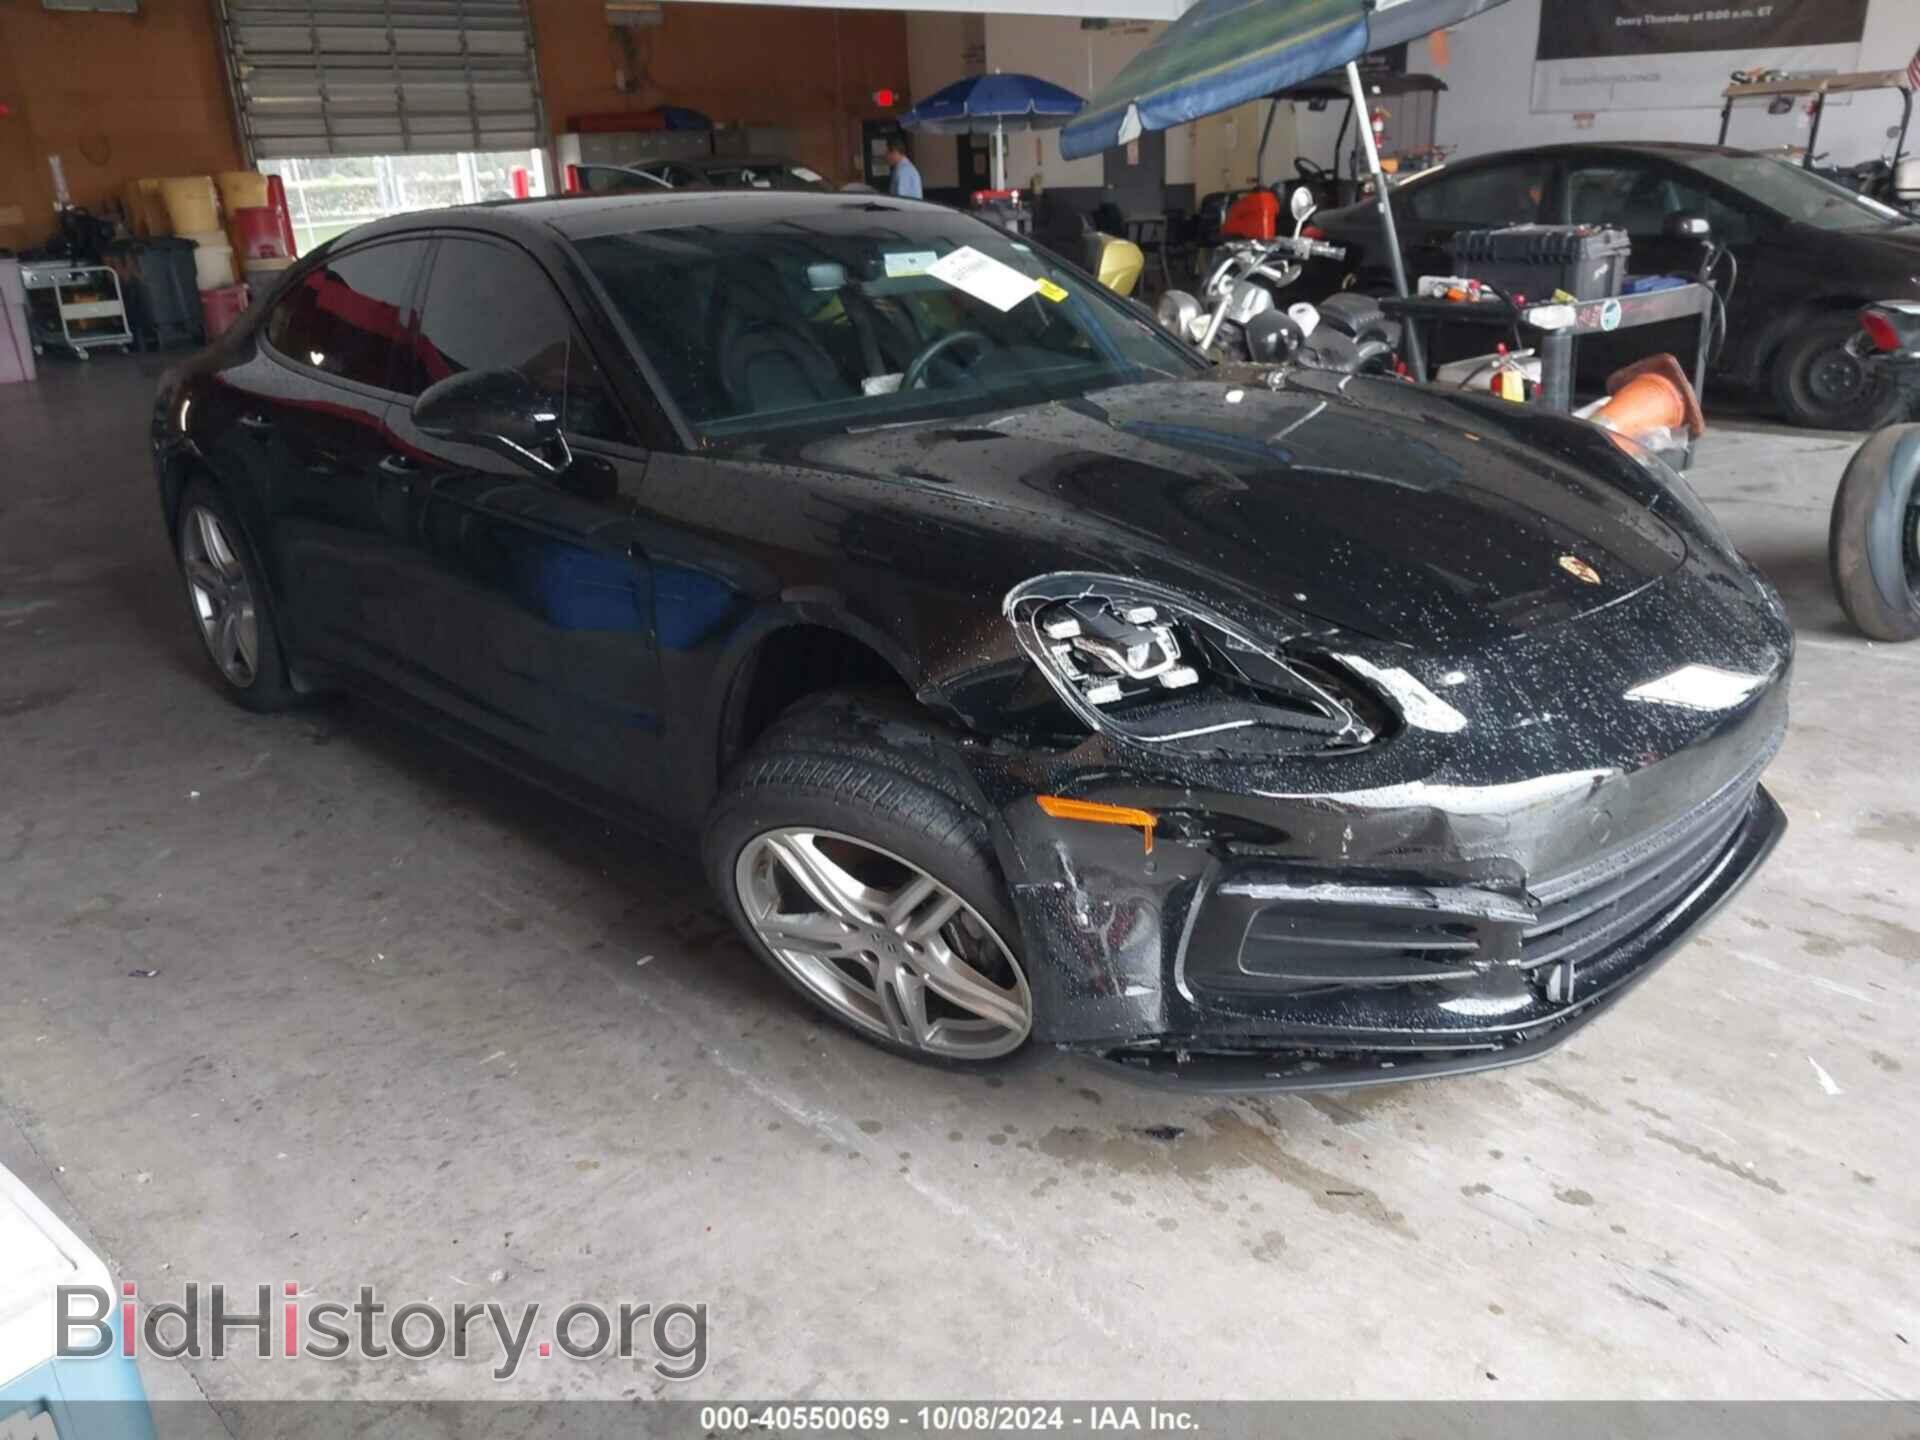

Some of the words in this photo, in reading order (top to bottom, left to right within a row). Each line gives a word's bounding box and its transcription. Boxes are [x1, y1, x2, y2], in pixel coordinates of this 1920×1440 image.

[1615, 16, 1642, 27] Every
[1644, 13, 1690, 25] Thursday
[1692, 11, 1703, 21] at
[1757, 6, 1774, 17] ET
